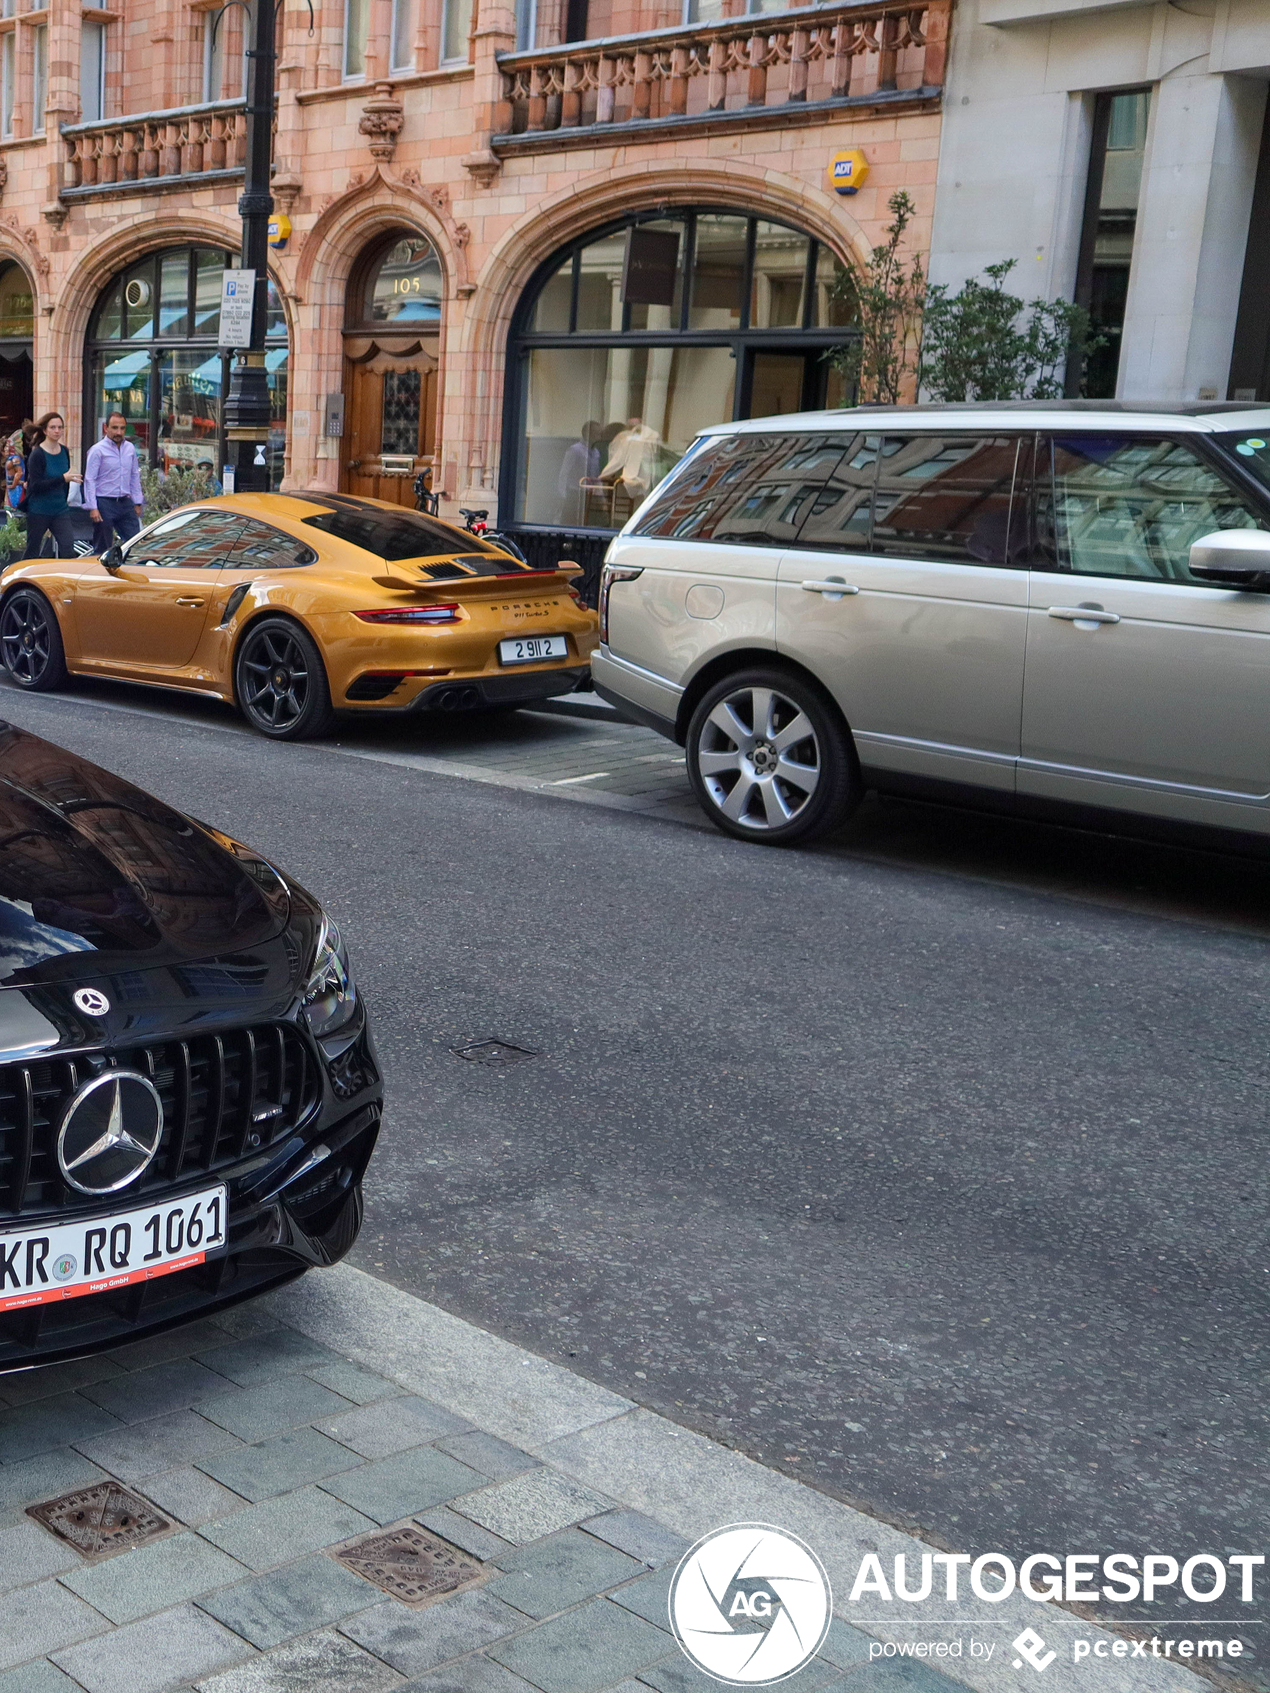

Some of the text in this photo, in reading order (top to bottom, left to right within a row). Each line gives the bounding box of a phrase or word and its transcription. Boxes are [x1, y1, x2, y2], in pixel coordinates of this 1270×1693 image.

[834, 162, 853, 176] ADT
[393, 277, 420, 294] 105
[240, 356, 246, 365] 6
[490, 600, 559, 611] PORSCHE
[515, 640, 553, 658] 2 911 2
[84, 1222, 131, 1276] RQ
[143, 1196, 222, 1262] 1061
[90, 1276, 129, 1291] Hago GmbH
